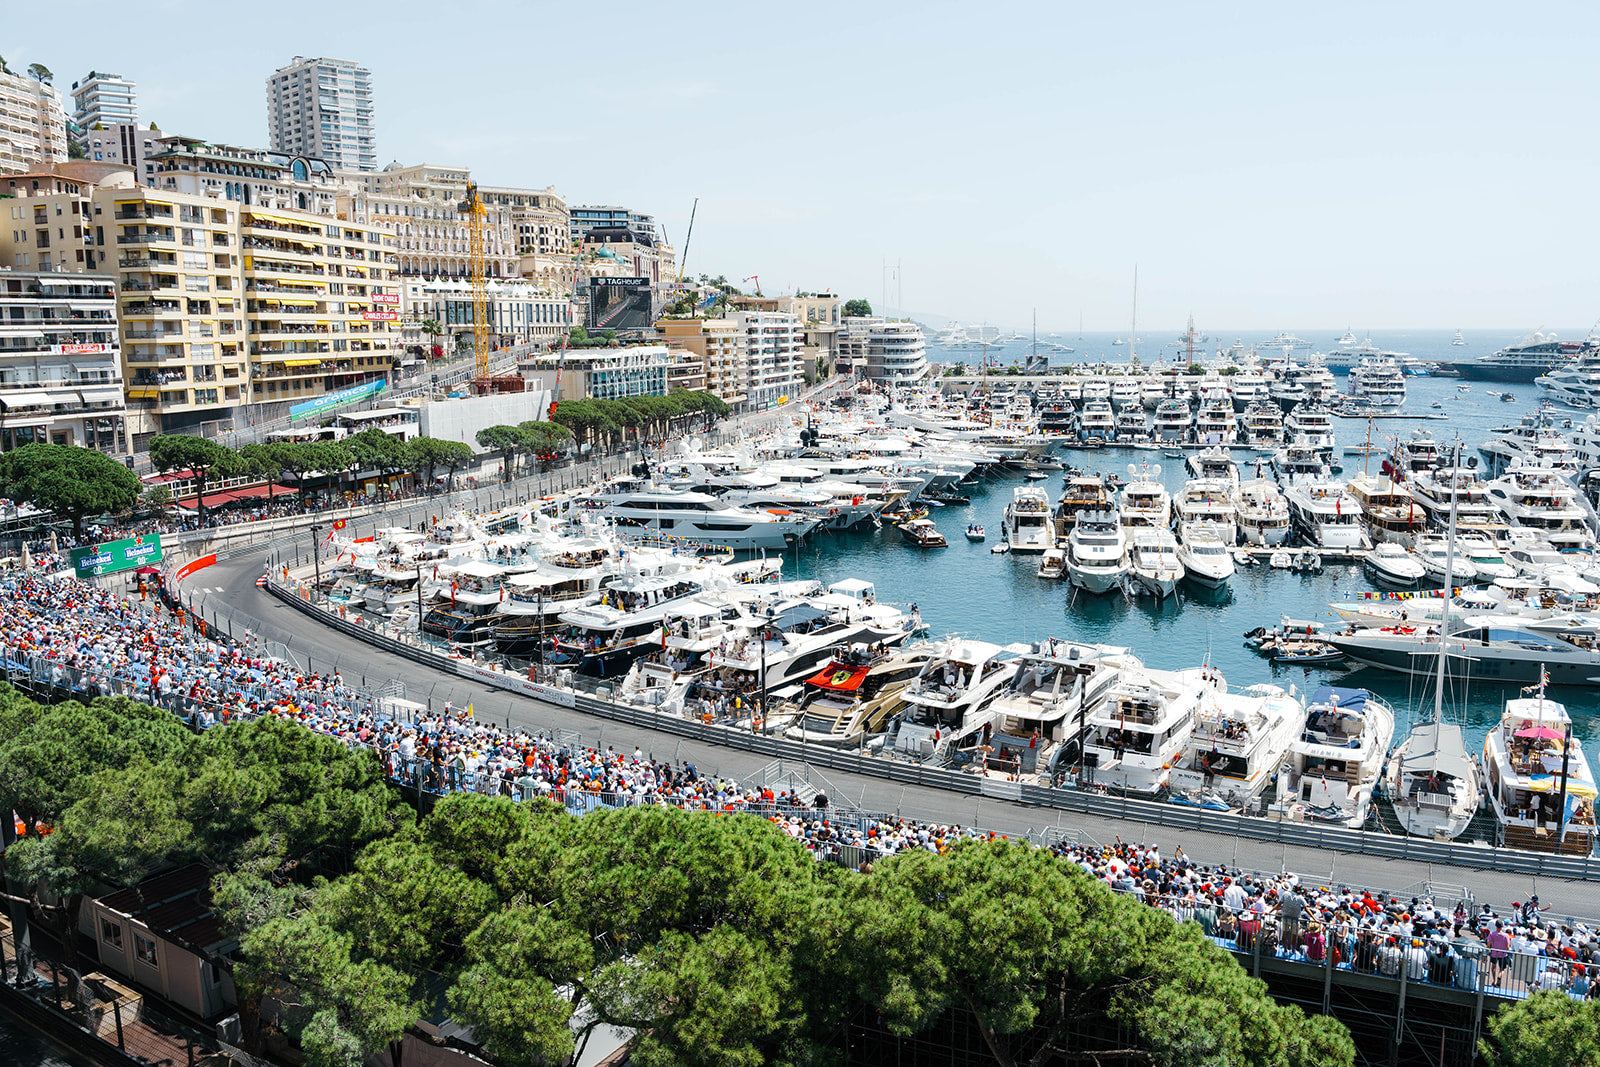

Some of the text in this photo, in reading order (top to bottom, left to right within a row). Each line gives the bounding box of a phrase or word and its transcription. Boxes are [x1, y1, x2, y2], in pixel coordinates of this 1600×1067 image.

[314, 386, 367, 406] aramco
[126, 544, 155, 558] Heineken
[81, 553, 112, 567] Heineken
[1312, 936, 1317, 945] 7
